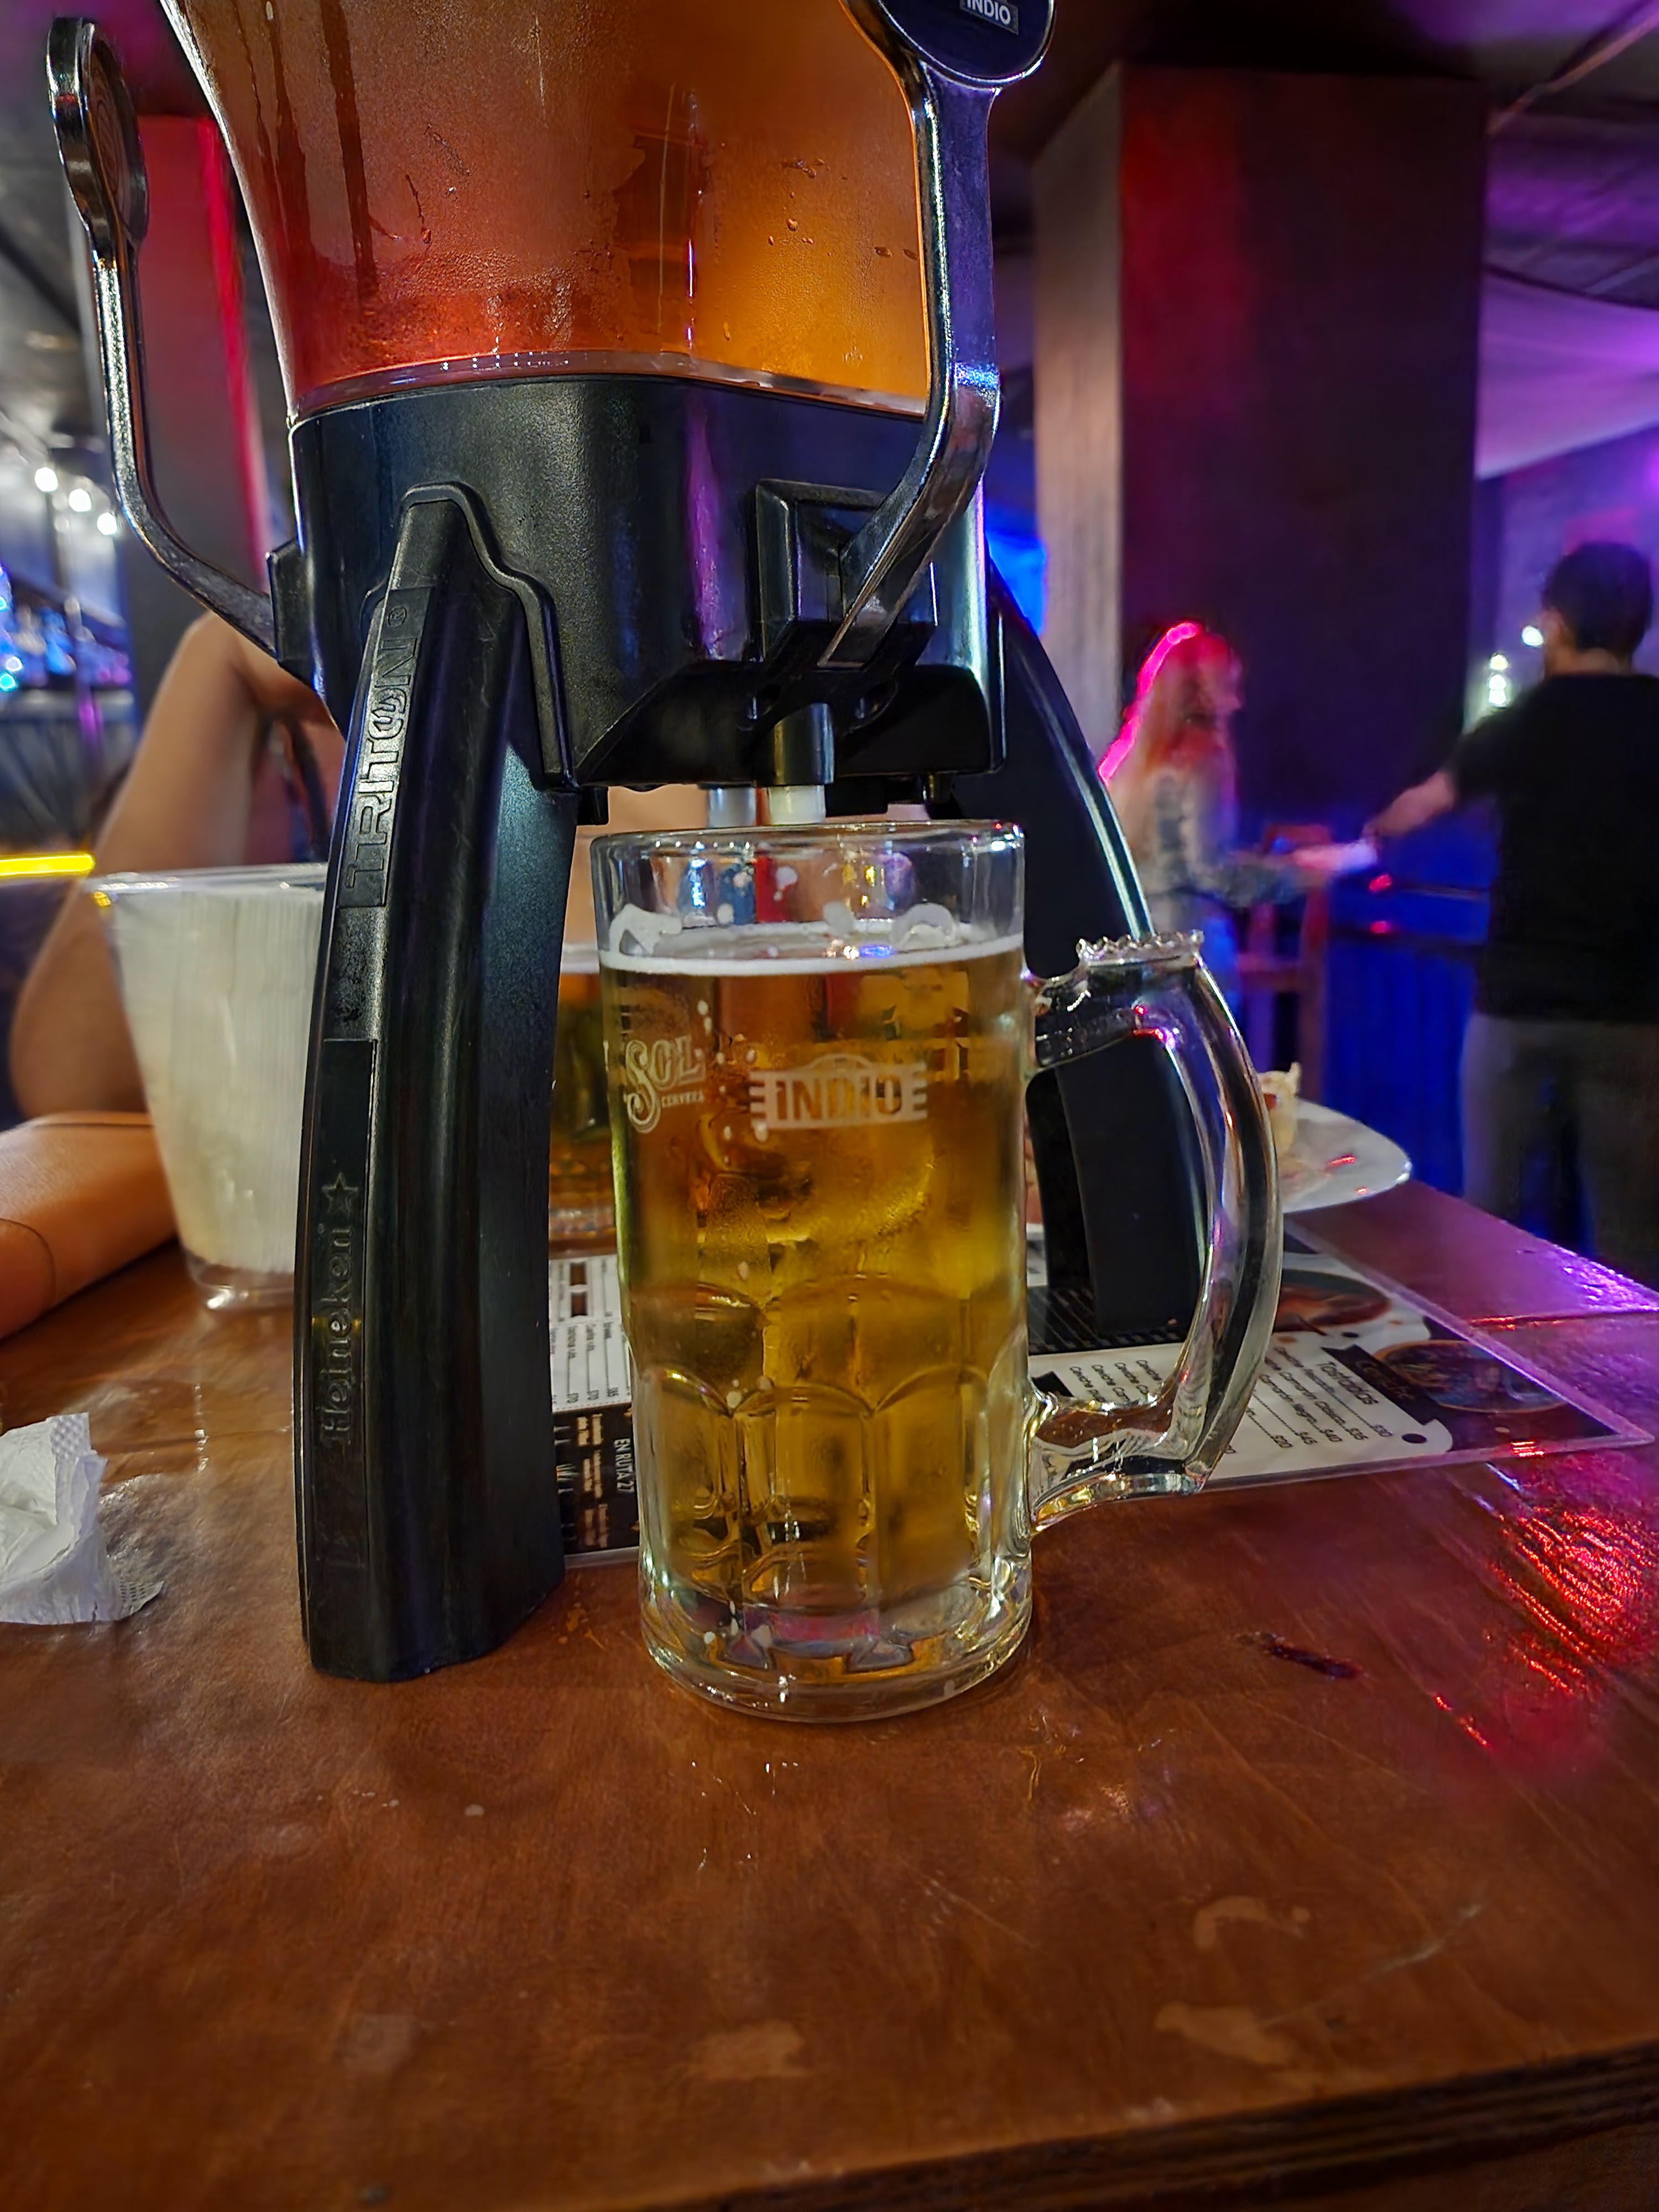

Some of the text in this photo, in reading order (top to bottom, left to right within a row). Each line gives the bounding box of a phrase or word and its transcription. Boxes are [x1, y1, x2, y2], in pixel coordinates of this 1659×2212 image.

[345, 637, 418, 888] TRITON
[319, 1228, 352, 1445] Heineken
[1316, 1361, 1379, 1405] Tostadas
[613, 1438, 632, 1451] EN
[615, 1453, 635, 1480] RUTA
